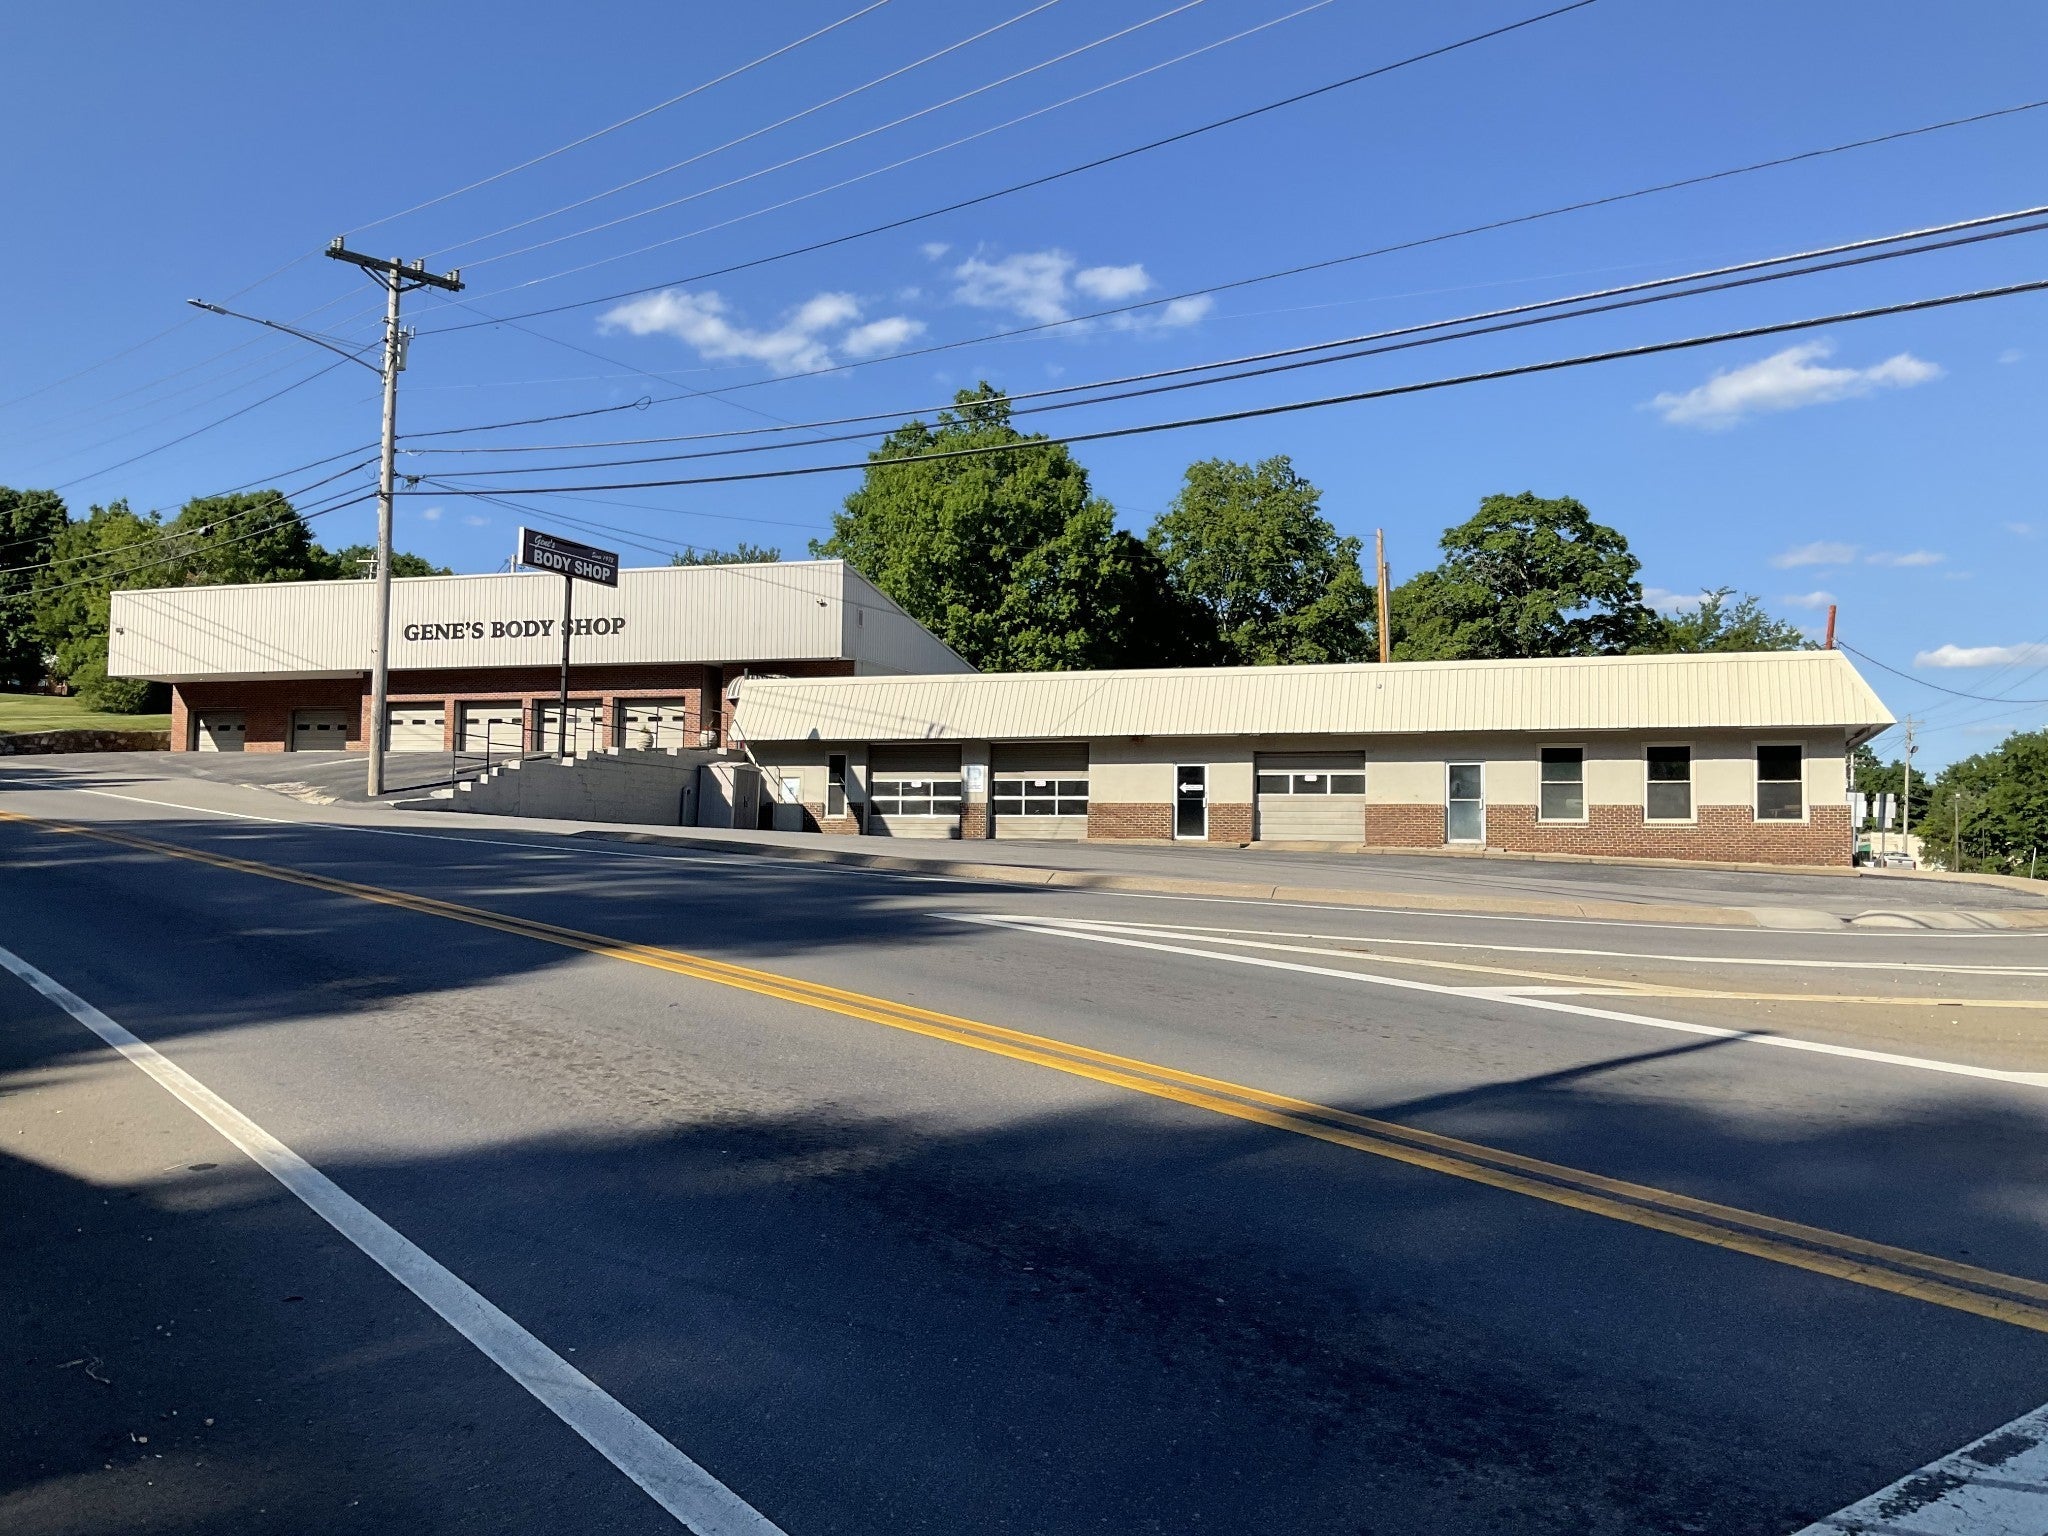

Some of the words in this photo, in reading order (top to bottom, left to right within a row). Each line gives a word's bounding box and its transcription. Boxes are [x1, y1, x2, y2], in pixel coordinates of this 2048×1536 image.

[533, 549, 572, 572] BODY
[574, 560, 611, 581] SHOP
[403, 621, 484, 641] GENE'S
[490, 619, 555, 638] BODY
